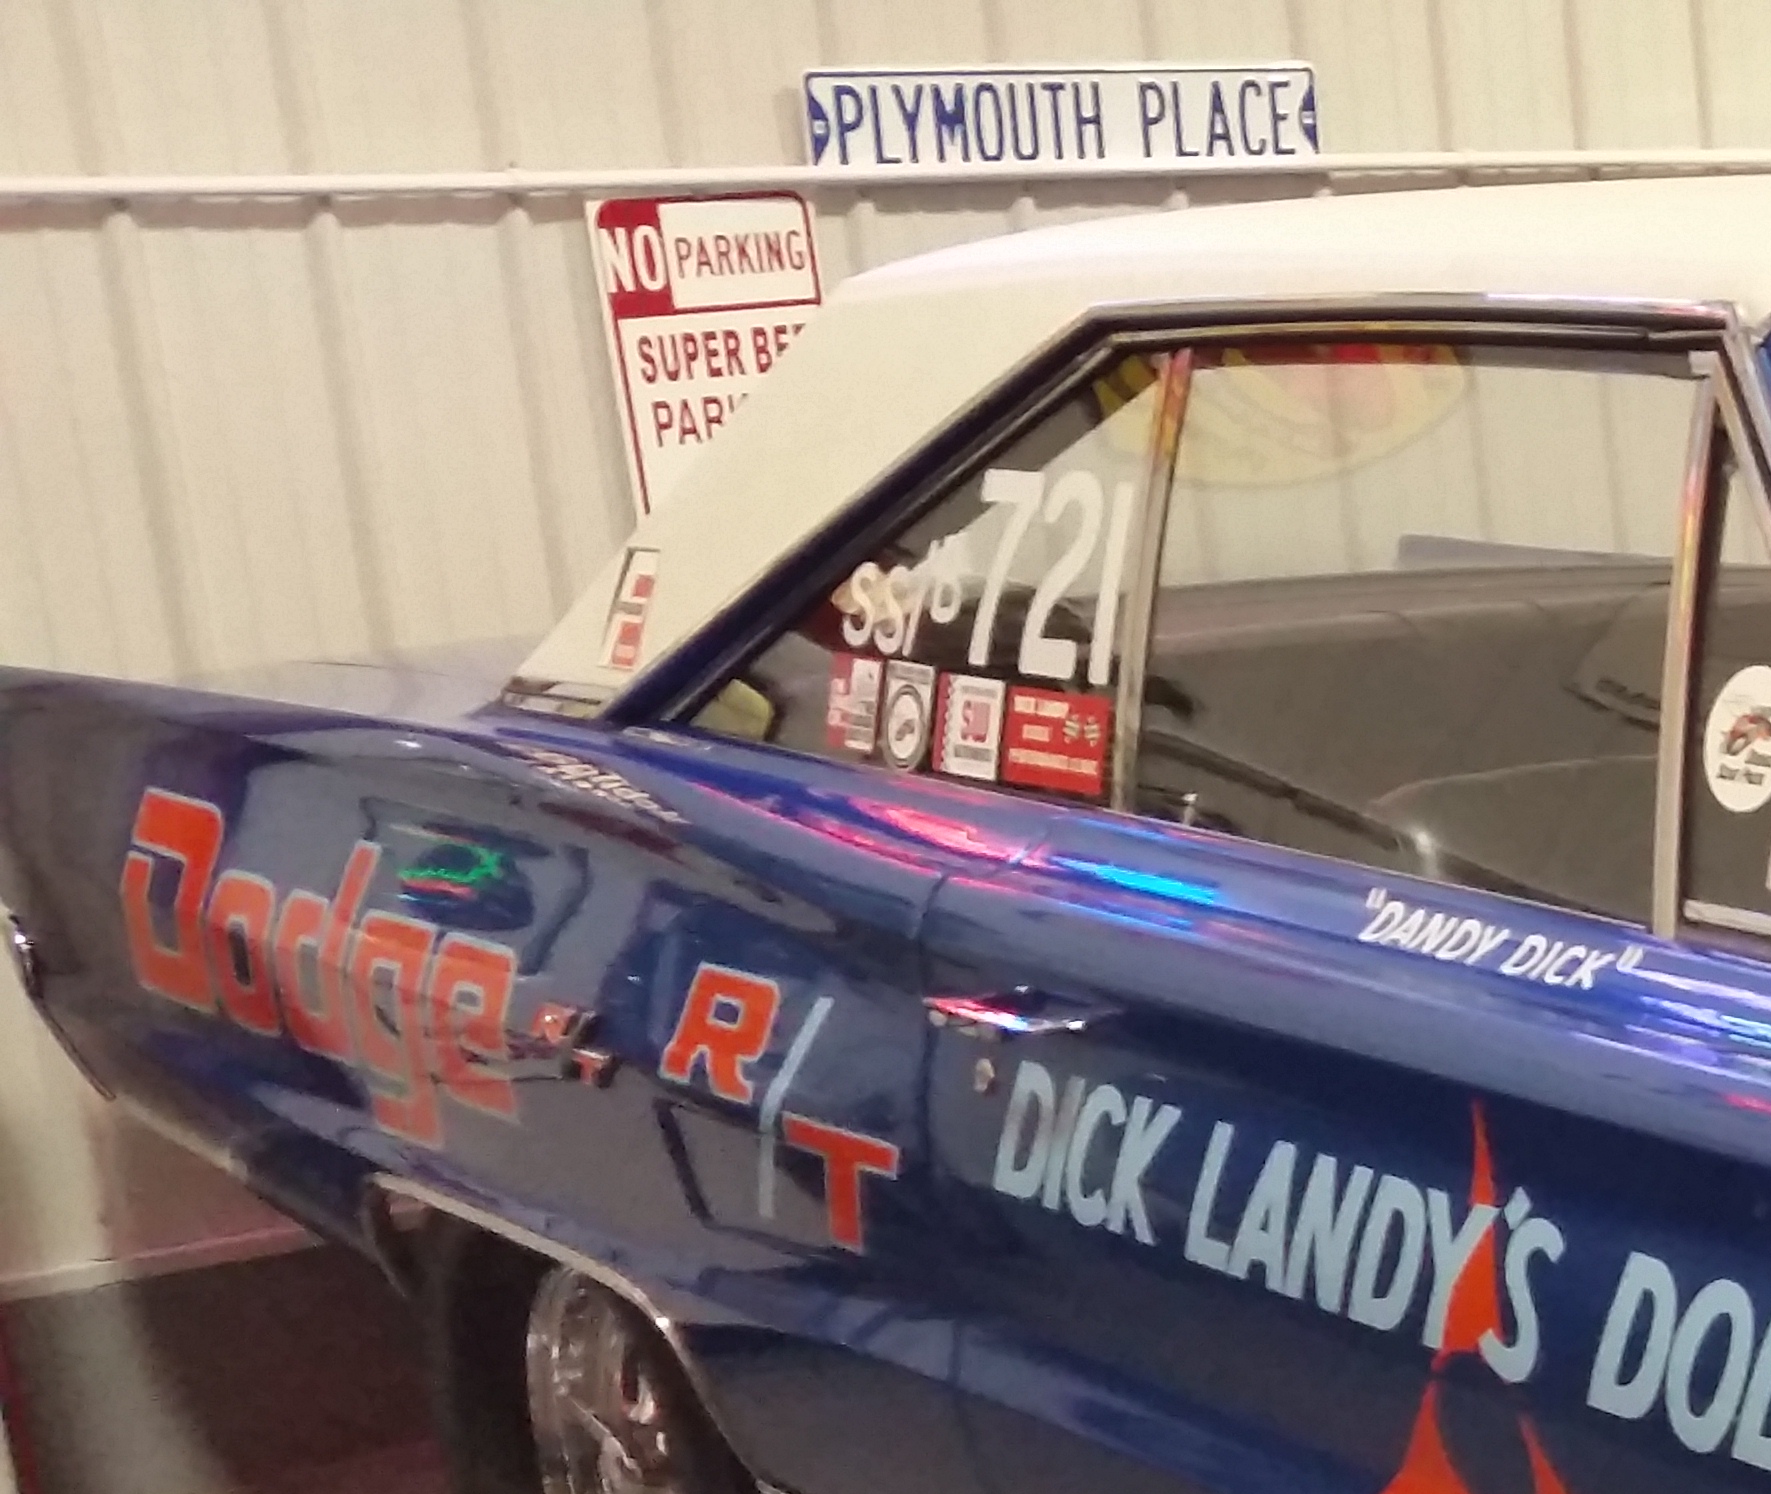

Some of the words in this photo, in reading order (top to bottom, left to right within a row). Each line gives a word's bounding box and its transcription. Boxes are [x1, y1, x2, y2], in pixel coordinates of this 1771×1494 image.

[832, 81, 1106, 166] PLYMOUTH
[1138, 79, 1296, 158] PLACE
[597, 224, 669, 293] NO
[673, 229, 806, 279] PARKING
[637, 328, 748, 384] SUPER
[750, 322, 806, 374] BE
[968, 467, 1136, 686] 721
[120, 786, 520, 1147] Dodge
[661, 962, 902, 1252] R/T
[993, 1060, 1183, 1248] DICK
[1183, 1119, 1566, 1385] LANDY'S
